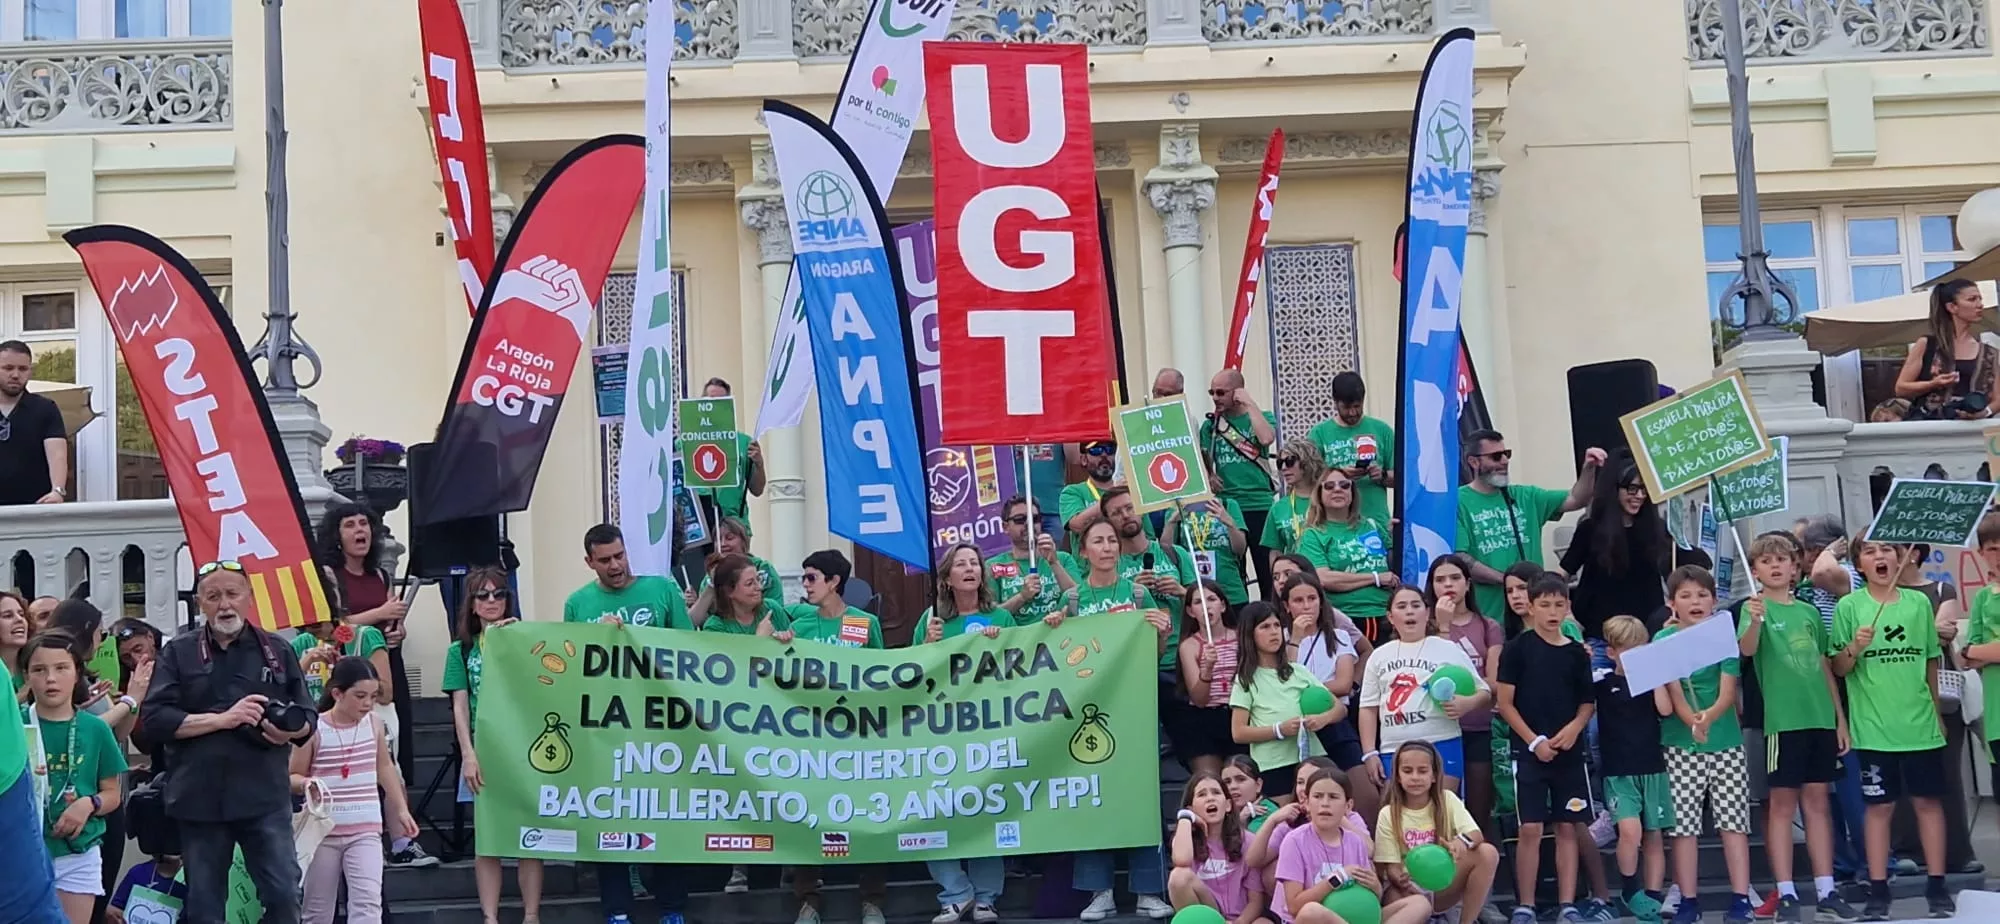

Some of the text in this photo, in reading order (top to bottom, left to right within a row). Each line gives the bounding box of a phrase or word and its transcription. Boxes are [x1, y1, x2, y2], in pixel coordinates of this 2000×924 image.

[848, 95, 864, 107] por
[876, 106, 911, 129] contigo
[951, 63, 1076, 415] UGT
[494, 338, 554, 372] Aragón
[486, 354, 552, 391] La Rioja
[471, 374, 554, 424] CGT
[698, 402, 713, 412] NO
[700, 417, 713, 427] AL
[1144, 409, 1163, 421] NO
[1646, 404, 1693, 437] ESCUELA
[681, 431, 736, 442] CONCIERTO
[1151, 424, 1166, 435] AL
[1666, 418, 1737, 457] DE TOD@S
[1129, 435, 1193, 456] CONCIERTO
[1663, 458, 1705, 483] PARA
[1708, 437, 1755, 461] TOD@S
[1721, 483, 1735, 496] DE
[1898, 487, 1944, 499] ESCUELA
[1715, 501, 1748, 518] PRA
[1896, 510, 1916, 521] DE
[582, 642, 1060, 694] DINERO PÚBLICO, PARA
[580, 687, 1074, 740] LA EDUCACIÓN PÚBLICA
[1384, 710, 1427, 727] STONES
[613, 736, 1029, 782] ¡NO AL CONCIERTO DEL
[537, 774, 1103, 830] BACHILLERATO, 0-3 AÑOS Y FP!
[602, 832, 625, 841] CGT
[708, 836, 752, 848] CCOO
[900, 838, 918, 847] UGT
